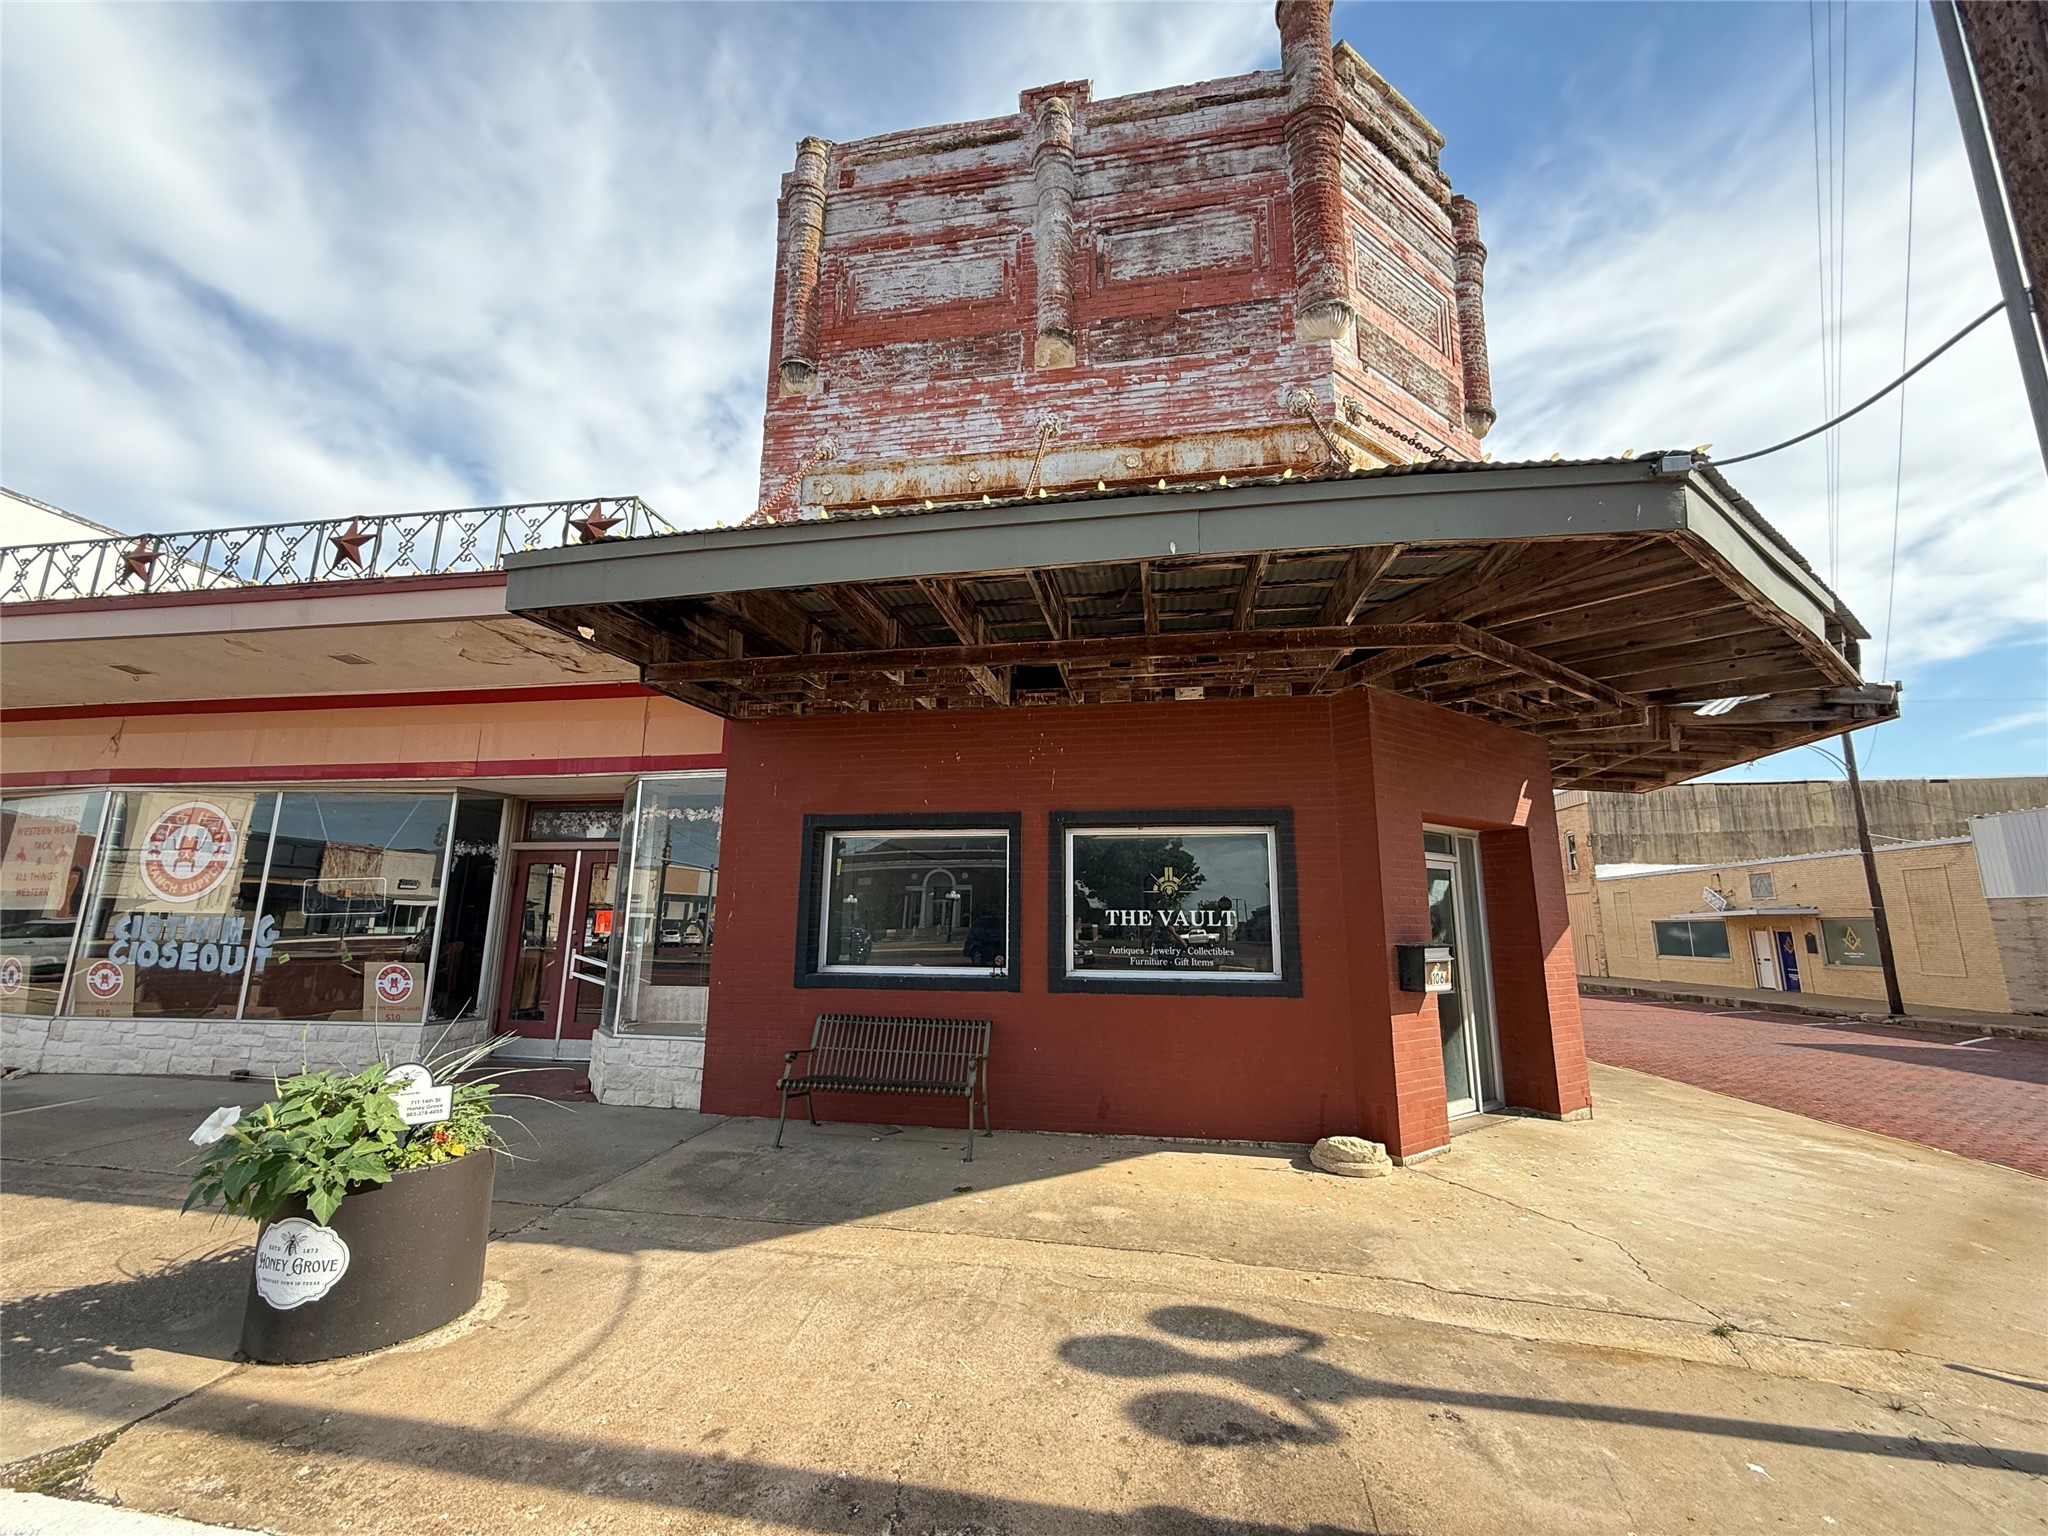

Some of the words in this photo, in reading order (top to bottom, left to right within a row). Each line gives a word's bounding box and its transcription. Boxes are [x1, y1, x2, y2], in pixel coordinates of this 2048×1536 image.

[17, 826, 52, 836] WESTERN
[53, 825, 78, 834] WEAR
[33, 841, 53, 850] TACK
[15, 872, 28, 881] ALL
[30, 871, 59, 881] THINGS
[150, 861, 179, 894] RANCH
[180, 860, 223, 894] SUPPLY
[16, 887, 49, 897] WESTERN
[1105, 909, 1152, 926] THE
[1157, 910, 1237, 926] VAULT
[1109, 946, 1145, 956] Antiques
[1150, 946, 1181, 956] Jewelry
[1187, 947, 1235, 956] Collectibles
[1130, 957, 1168, 966] Furniture
[1174, 958, 1189, 966] Gift
[1191, 958, 1214, 966] Items
[258, 1251, 289, 1272] HONEY
[286, 1257, 339, 1277] GROVE
